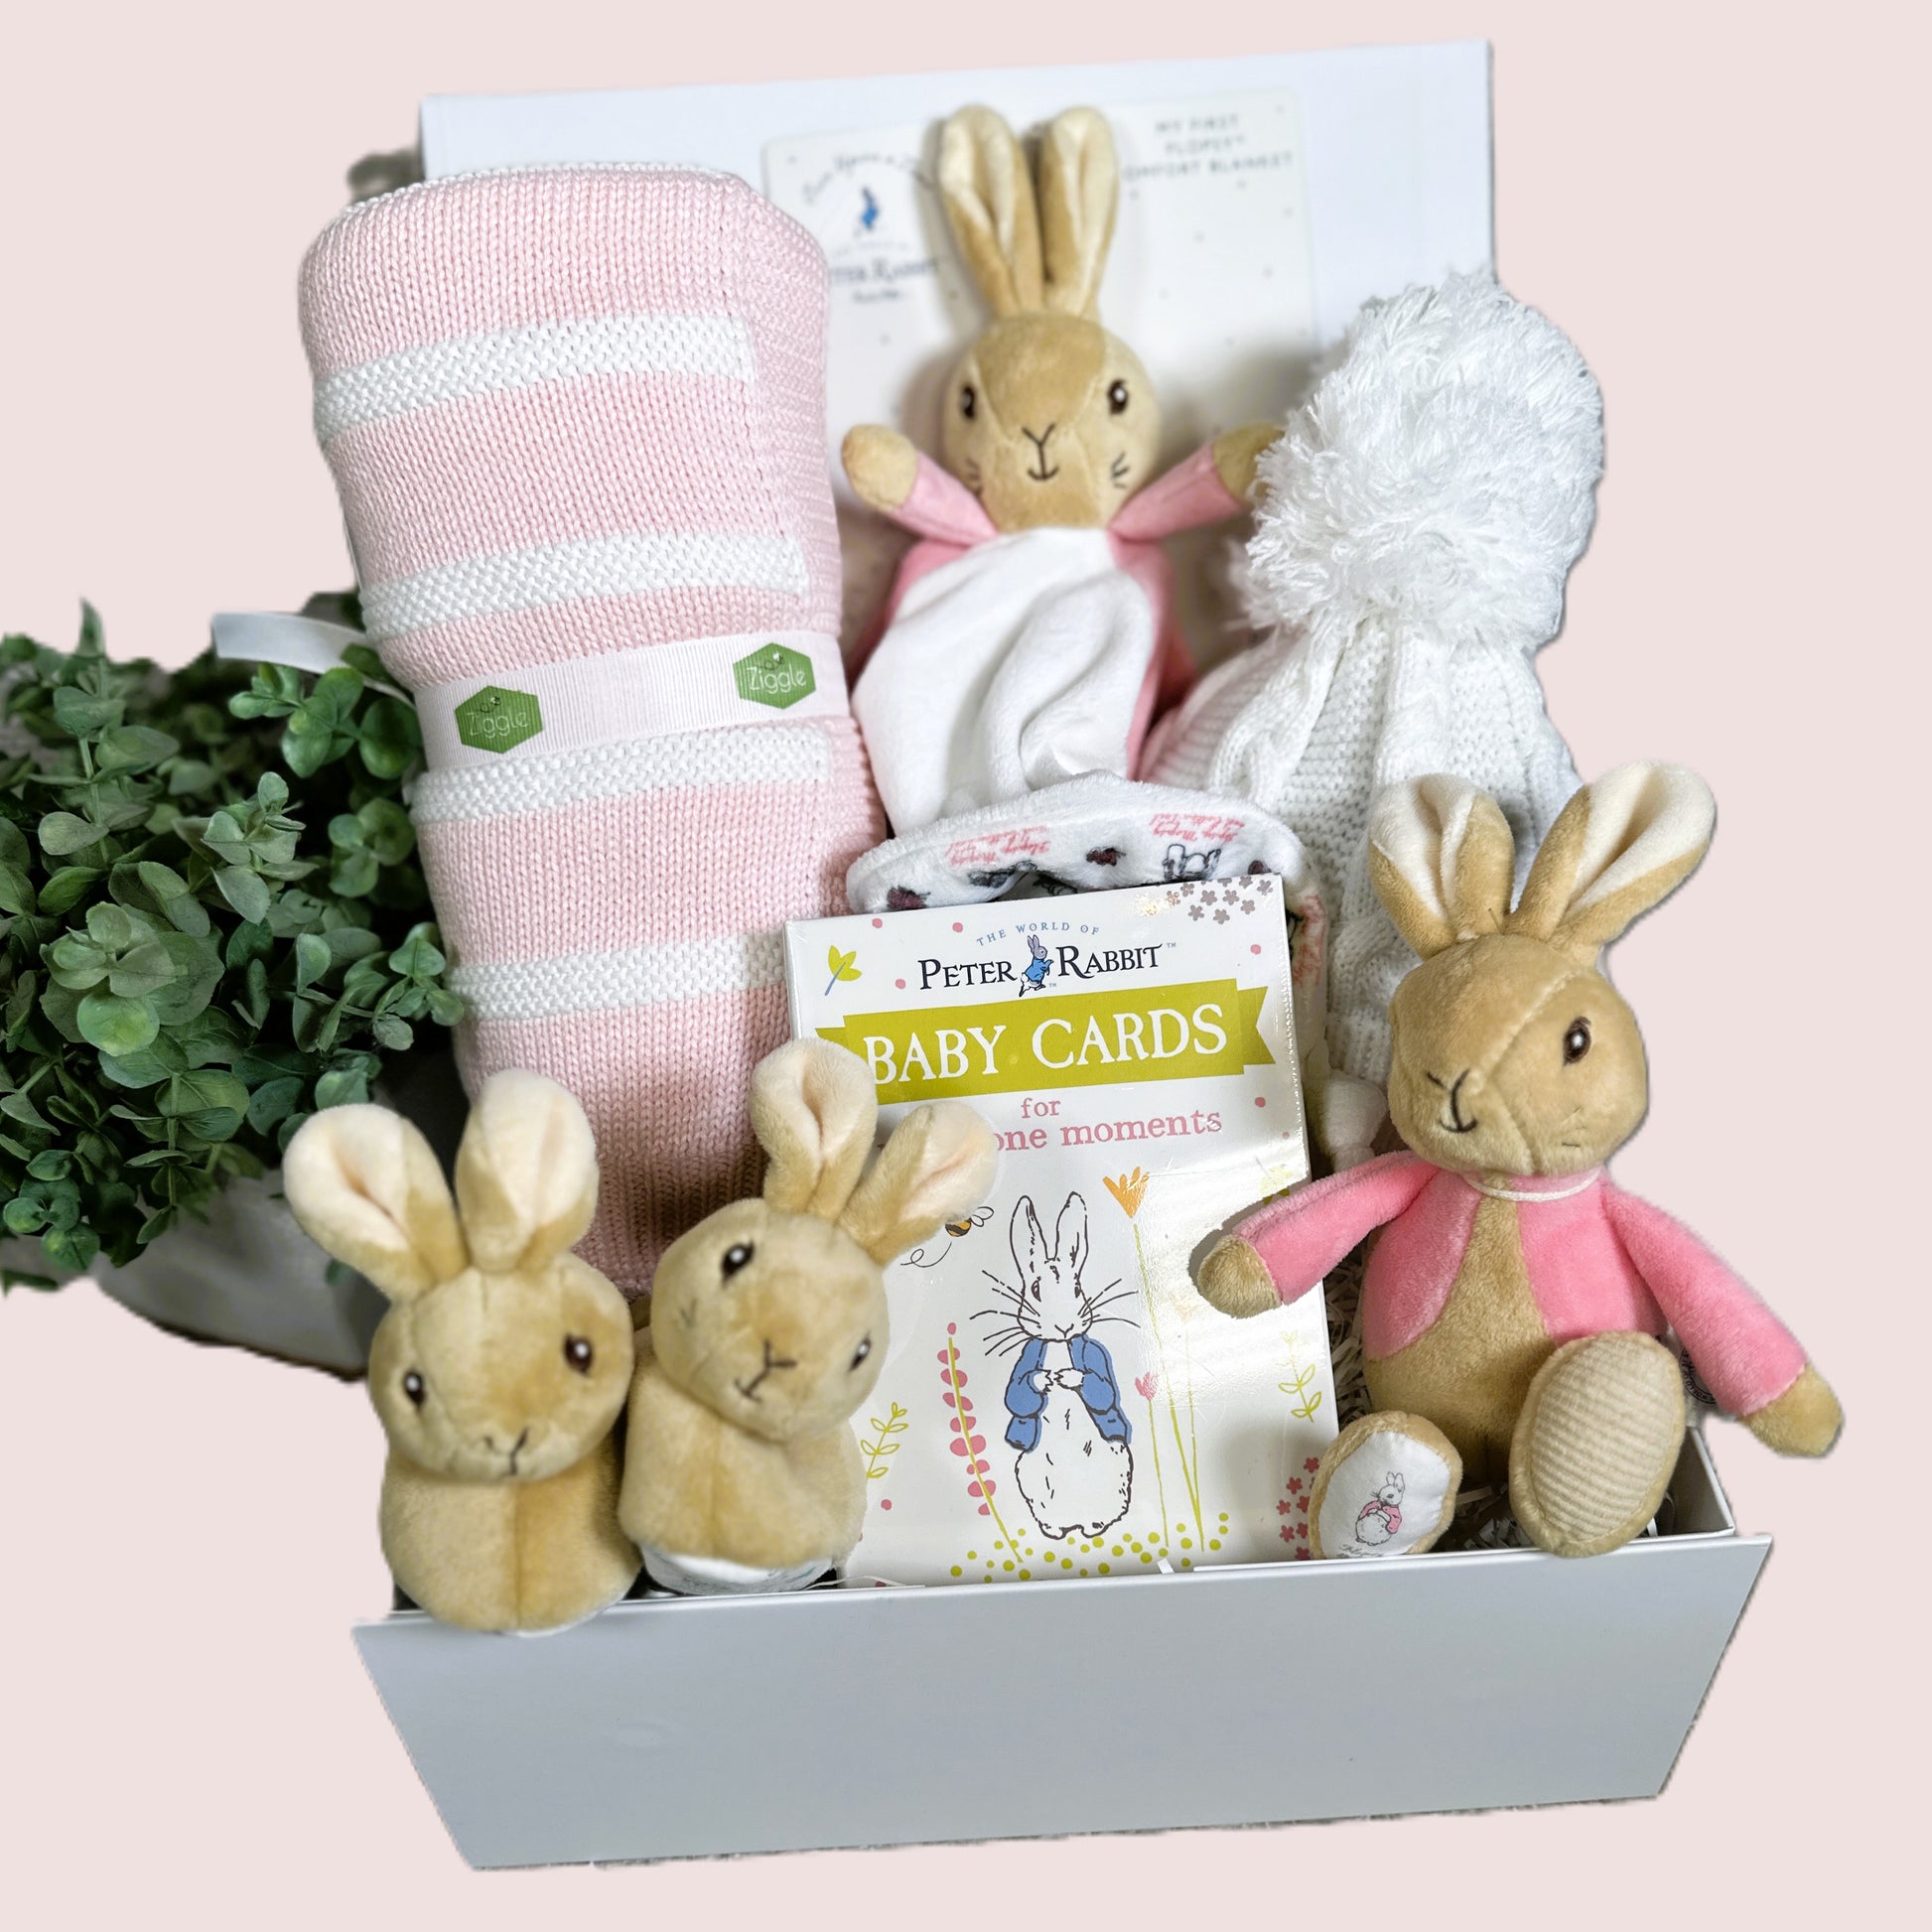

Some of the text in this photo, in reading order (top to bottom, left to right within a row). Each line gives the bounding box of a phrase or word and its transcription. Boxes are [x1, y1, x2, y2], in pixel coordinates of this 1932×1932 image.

[747, 664, 807, 695] Ziggle
[467, 710, 530, 739] Ziggle
[977, 921, 1100, 947] THE WORLD OF
[917, 958, 1018, 991] PETER
[1055, 943, 1163, 980] RABBIT
[863, 1004, 1228, 1085] BABY CARDS
[1021, 1097, 1061, 1119] for
[1059, 1109, 1223, 1147] moments
